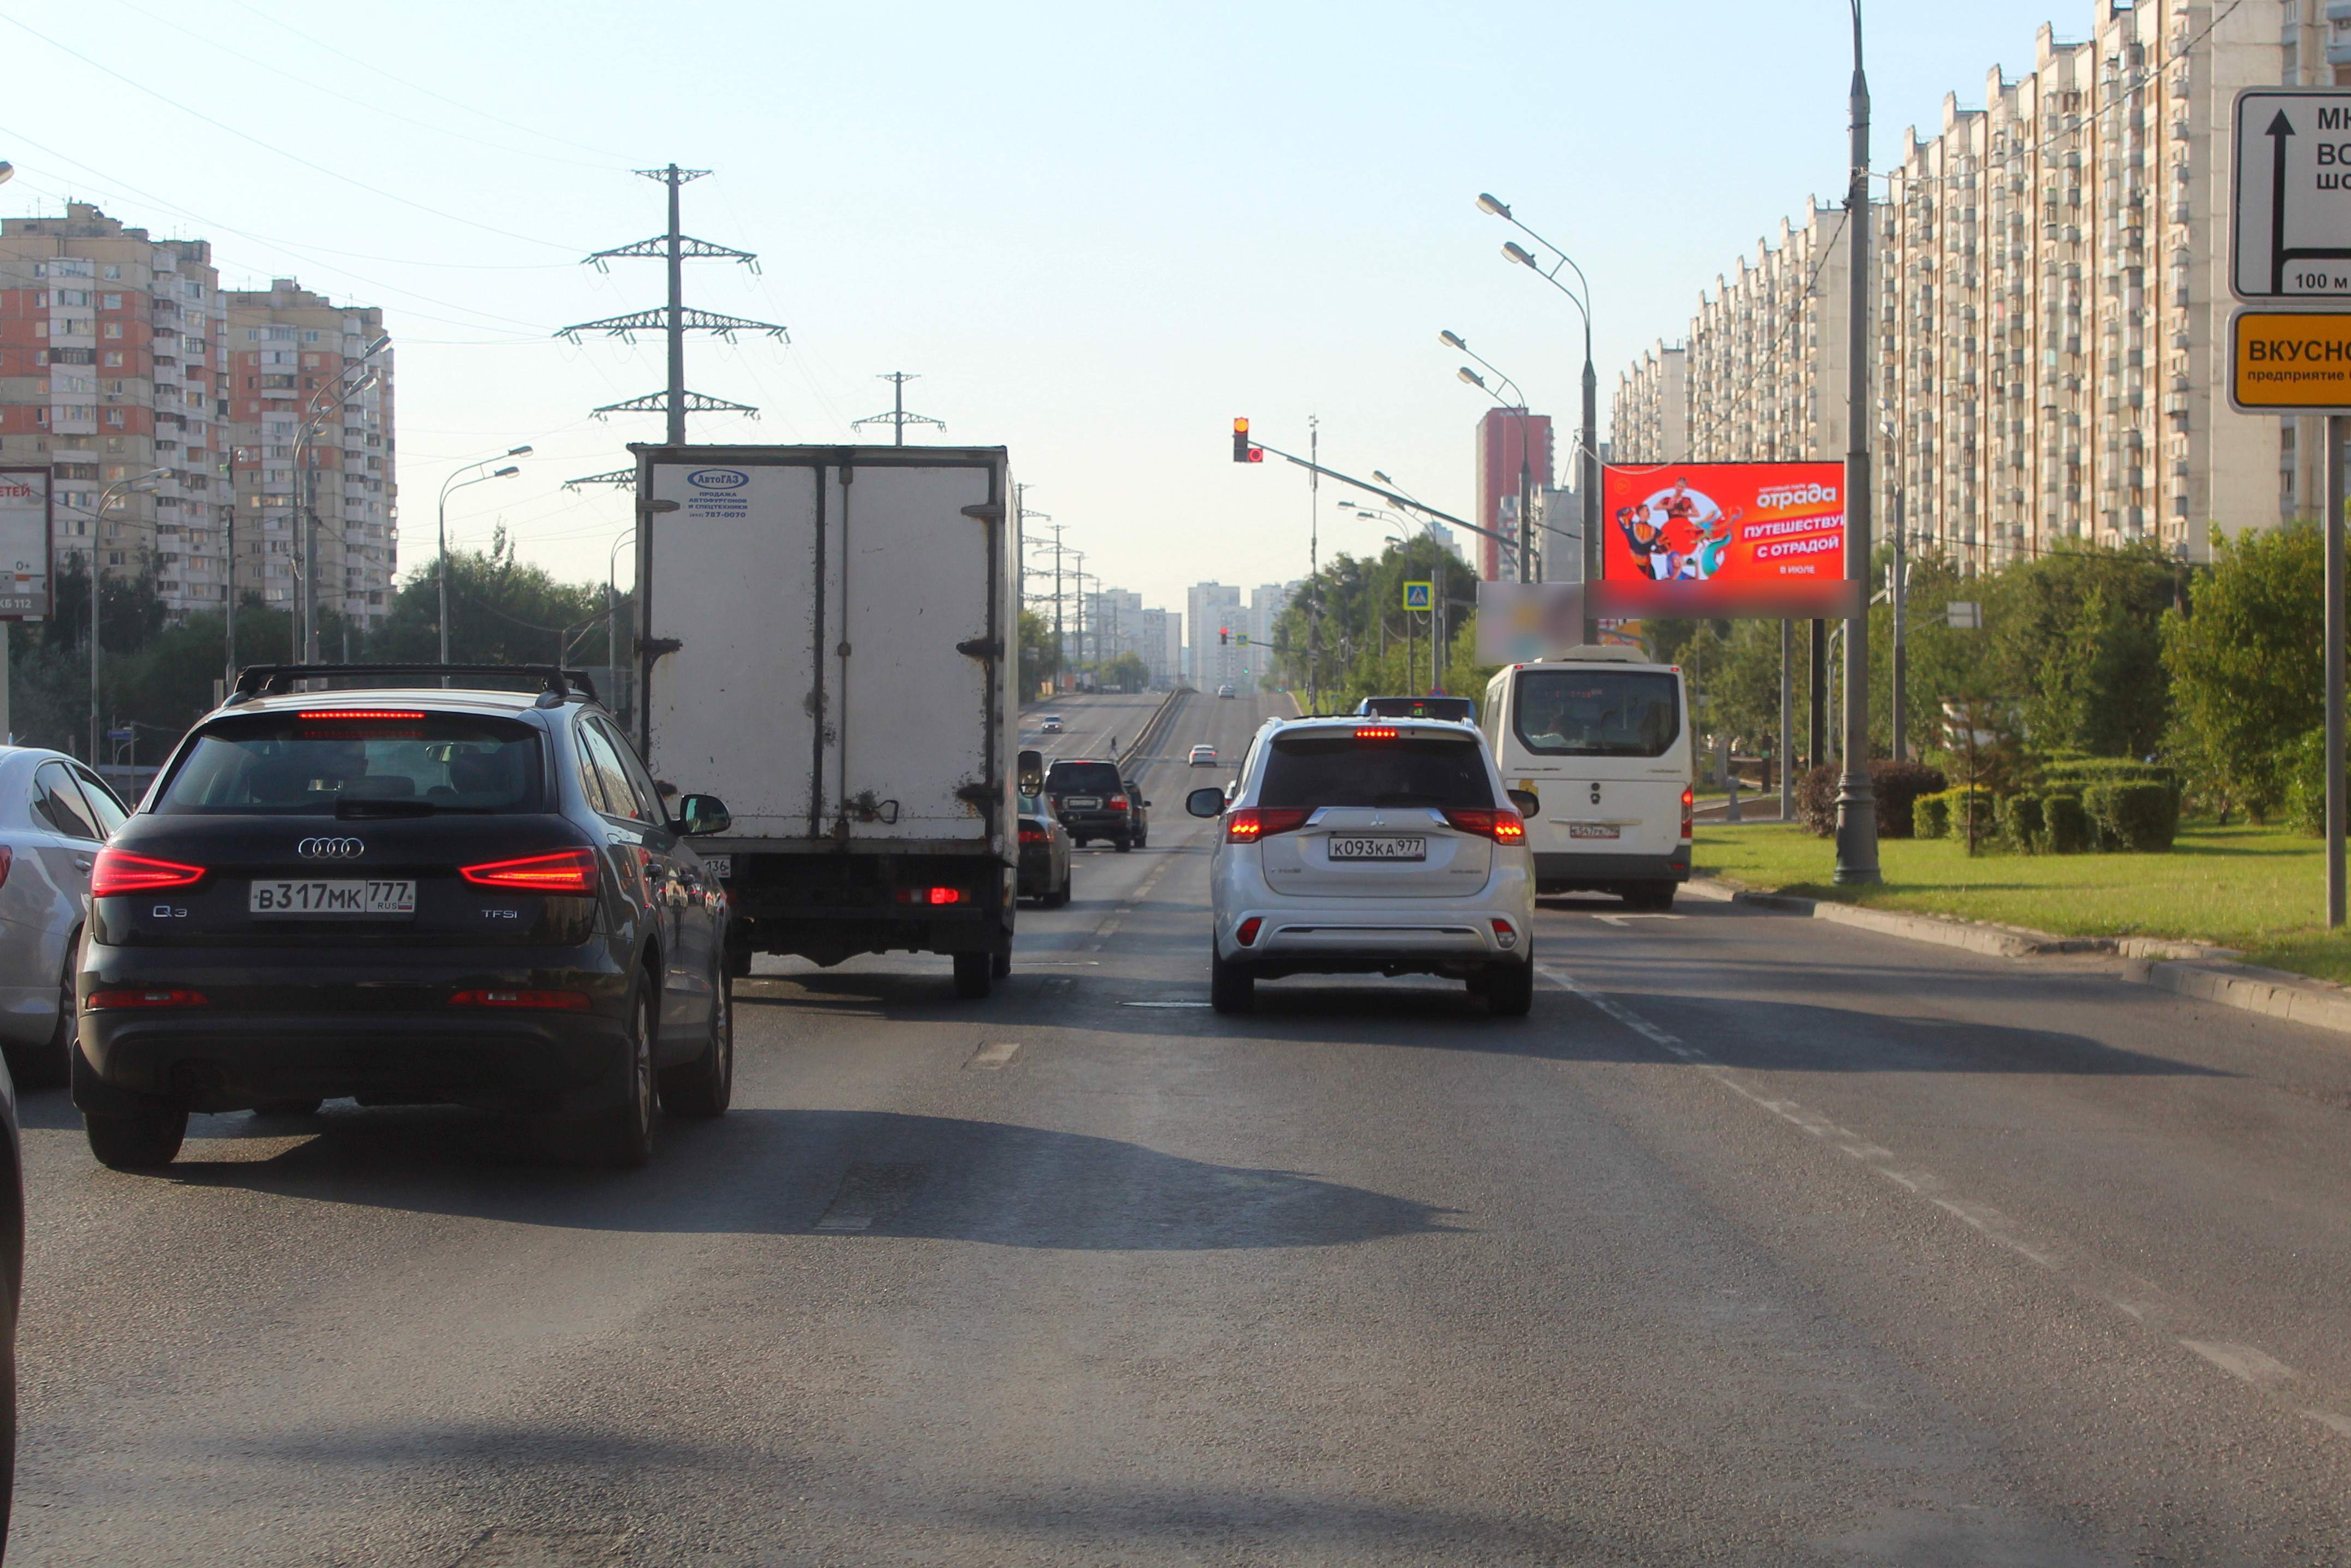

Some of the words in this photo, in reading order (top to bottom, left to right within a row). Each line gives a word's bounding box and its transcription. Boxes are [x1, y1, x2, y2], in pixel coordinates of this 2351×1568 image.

[2296, 274, 2326, 288] 100
[2334, 278, 2347, 288] м
[2249, 340, 2351, 361] ВКУСН
[2248, 371, 2344, 383] предприятие
[698, 475, 739, 484] АвтоГАЗ
[1756, 482, 1836, 510] отрада
[1757, 546, 1768, 558] С
[1770, 534, 1840, 557] ОТРАДОЙ
[1780, 566, 1786, 574] В
[1788, 565, 1815, 574] ИЮЛЕ
[14, 599, 31, 609] 112
[1335, 840, 1394, 855] К093КА
[1398, 840, 1420, 851] 977
[706, 861, 726, 872] 136
[259, 884, 361, 909] В317МК
[369, 883, 408, 901] 777
[153, 905, 187, 917] Q3
[481, 910, 517, 919] TFSI
